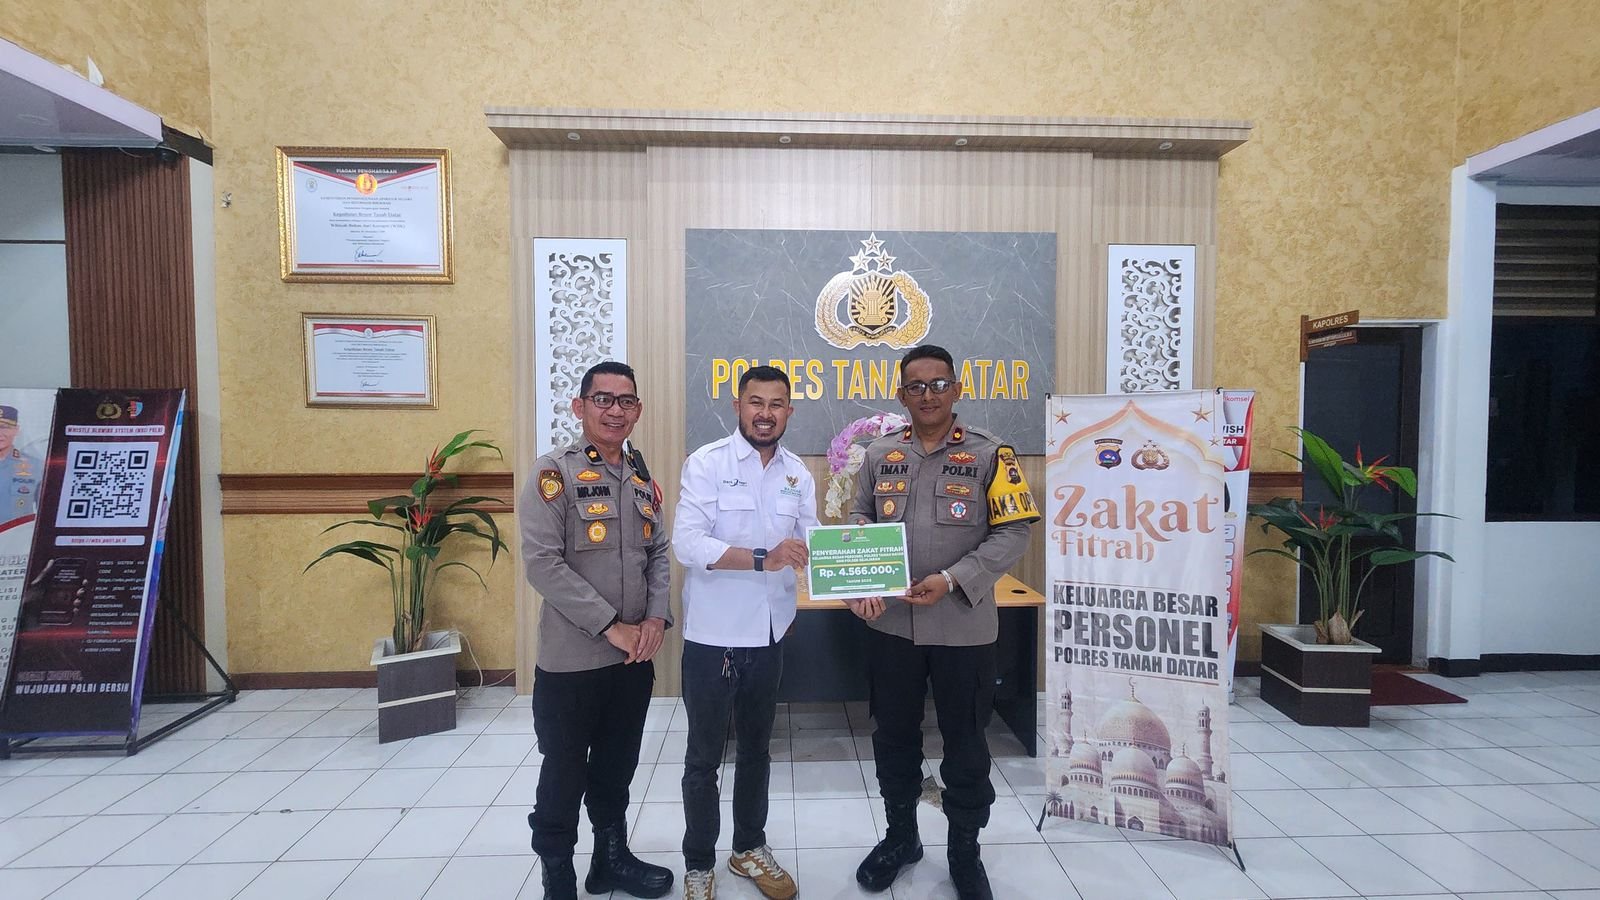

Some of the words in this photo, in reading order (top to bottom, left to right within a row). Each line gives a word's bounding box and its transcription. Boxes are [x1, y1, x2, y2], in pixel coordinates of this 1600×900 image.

[1312, 315, 1349, 328] KAPOLRES
[712, 358, 824, 400] POES
[832, 360, 902, 400] TANA
[959, 360, 1030, 400] ATAR
[880, 465, 909, 475] IMAN
[942, 465, 979, 478] POLRI
[1053, 483, 1219, 542] Zakat
[1051, 529, 1155, 564] Fitrah
[819, 569, 836, 578] Rp.
[838, 565, 899, 576] 4.566.000,-
[1053, 584, 1148, 611] KELUARGA
[1153, 592, 1219, 617] BESAR
[1054, 609, 1219, 659] PERSONEL
[1054, 646, 1108, 667] POLRES
[1112, 651, 1162, 674] TANAH
[1167, 657, 1219, 680] DATAR
[16, 684, 67, 694] WUJUDKAN
[70, 683, 96, 693] POLRI
[100, 683, 129, 693] BERSIH
